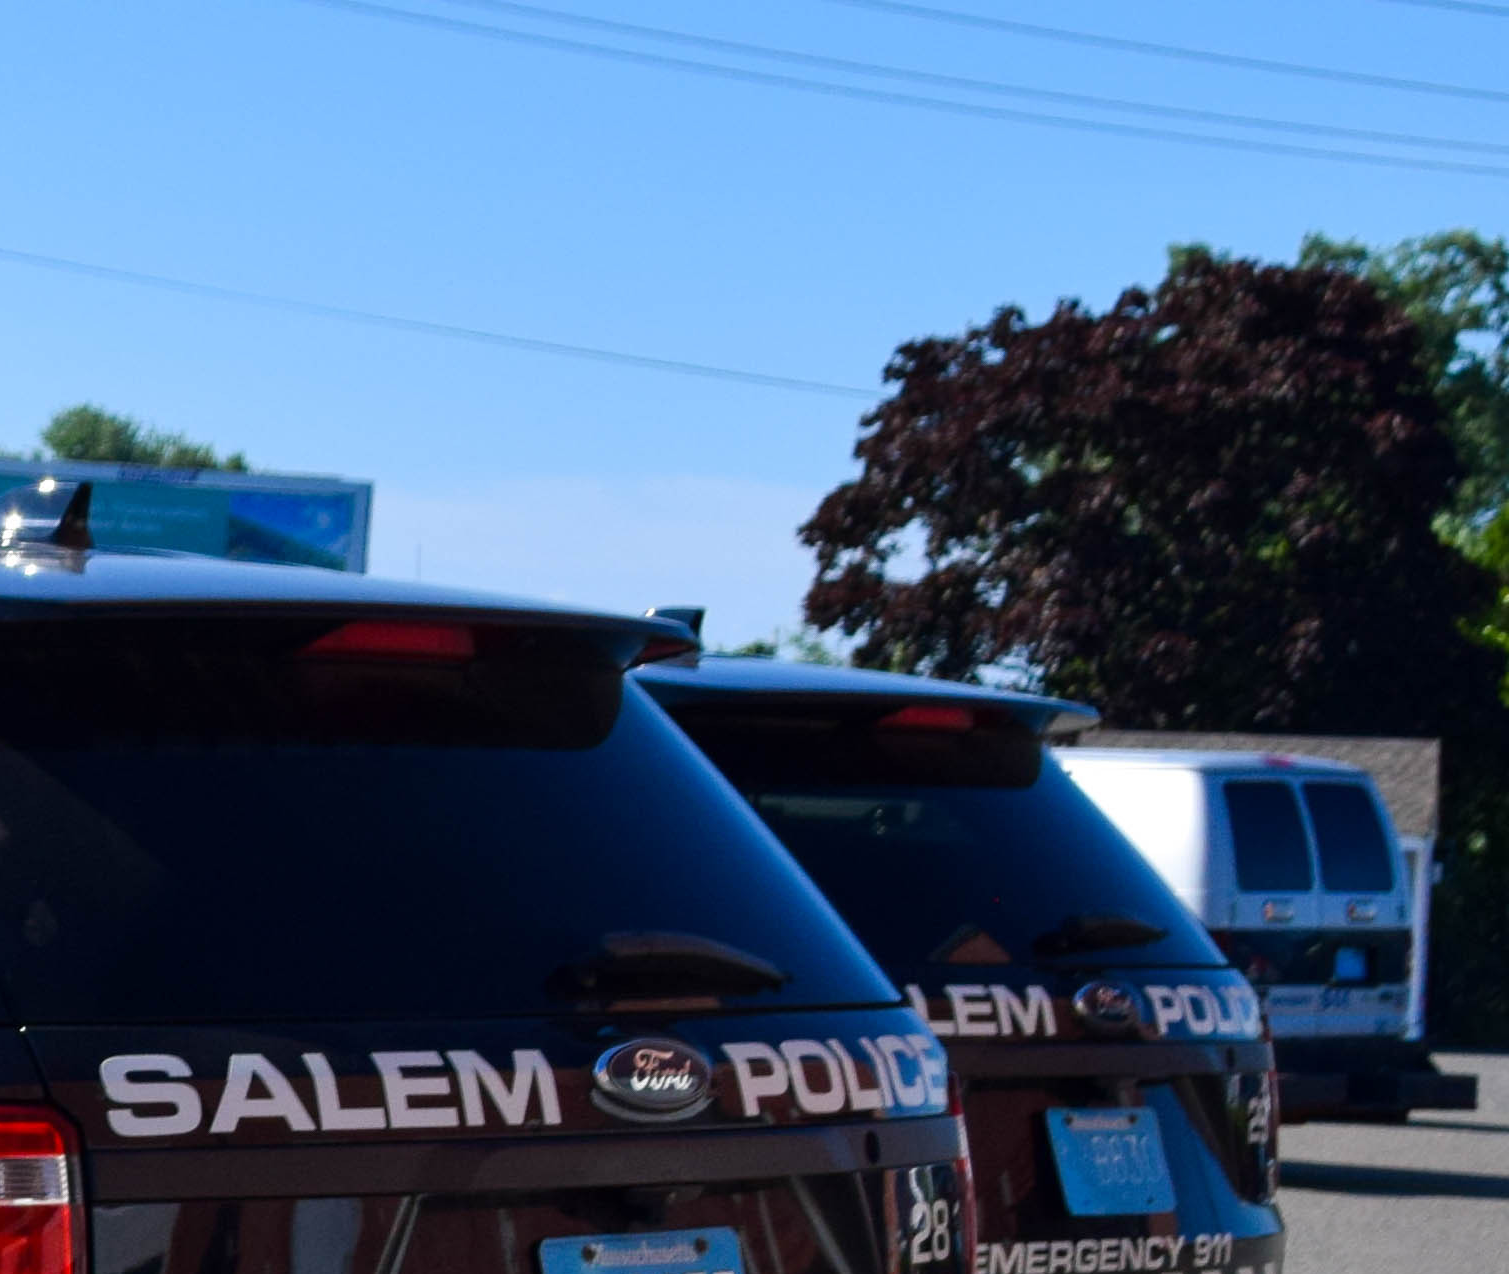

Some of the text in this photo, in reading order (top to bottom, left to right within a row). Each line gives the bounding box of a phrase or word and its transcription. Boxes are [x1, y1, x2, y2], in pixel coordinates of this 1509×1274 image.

[905, 984, 1058, 1036] LEM
[99, 1049, 562, 1137] SALEM
[629, 1047, 694, 1092] Ford
[722, 1034, 948, 1117] POLICE
[909, 1198, 951, 1264] 28
[1194, 1233, 1232, 1267] 911
